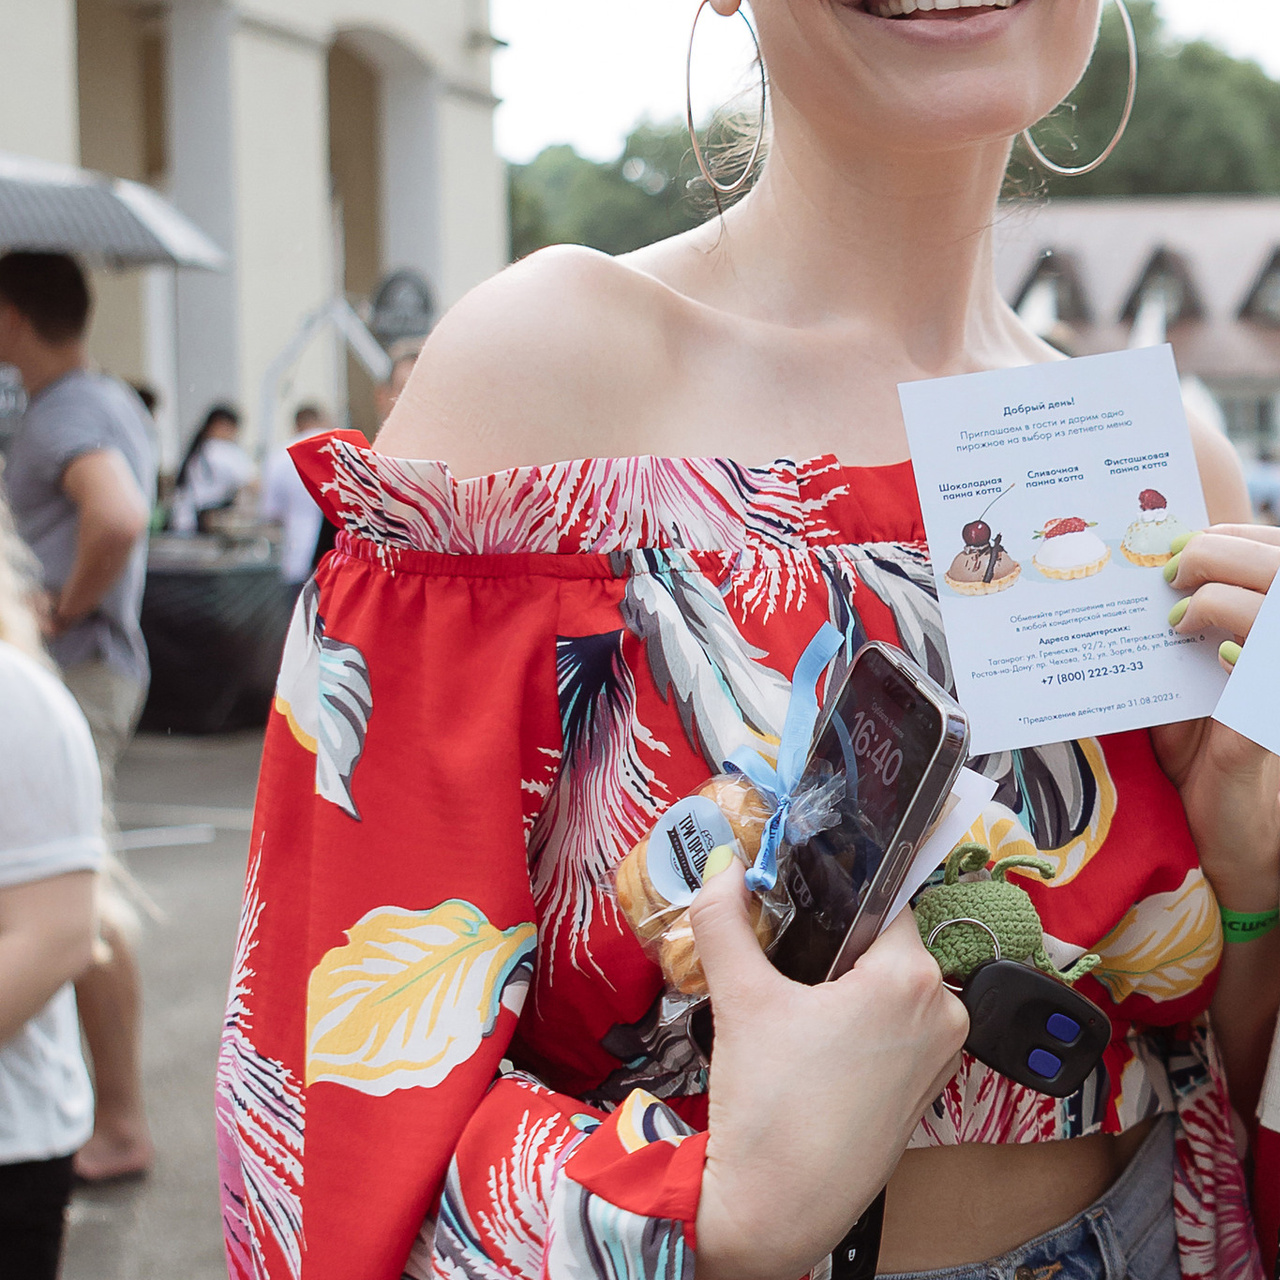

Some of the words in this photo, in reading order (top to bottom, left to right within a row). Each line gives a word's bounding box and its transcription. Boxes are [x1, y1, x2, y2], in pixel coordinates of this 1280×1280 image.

[1003, 402, 1046, 417] Добрый
[1048, 397, 1075, 410] день!
[956, 439, 1005, 453] пирожное
[1022, 430, 1052, 441] выбор
[1068, 424, 1105, 436] летнего
[1106, 419, 1133, 429] меню
[960, 425, 1022, 441] Приглашаем
[1032, 420, 1058, 429] гости
[1068, 413, 1099, 425] дарим
[1101, 409, 1125, 419] одно
[1104, 451, 1170, 467] Фисташковая
[1110, 465, 1140, 475] панна
[1142, 460, 1168, 470] котта
[1025, 478, 1056, 488] панна
[1058, 473, 1084, 483] котта
[1027, 465, 1079, 479] Сливочная
[938, 477, 1003, 493] Шоколадная
[943, 490, 973, 501] панна
[975, 486, 1002, 496] котта
[1010, 610, 1053, 623] Обменяйте
[1054, 603, 1104, 617] приглашение
[1117, 596, 1149, 607] подарок
[1022, 621, 1047, 632] любой
[1049, 612, 1101, 627] кондитерской
[1102, 608, 1127, 618] нашей
[1039, 635, 1070, 646] Адреса
[1071, 625, 1131, 640] кондитерских:
[1041, 675, 1054, 685] +7
[1057, 669, 1086, 685] (800)
[1087, 660, 1144, 679] 222-32-33
[1078, 704, 1115, 716] действует
[1116, 701, 1126, 710] до
[1127, 692, 1174, 708] 31.08.2023
[850, 711, 903, 786] 16:40
[678, 812, 697, 840] ТРИ
[687, 835, 709, 879] ОРЕШ
